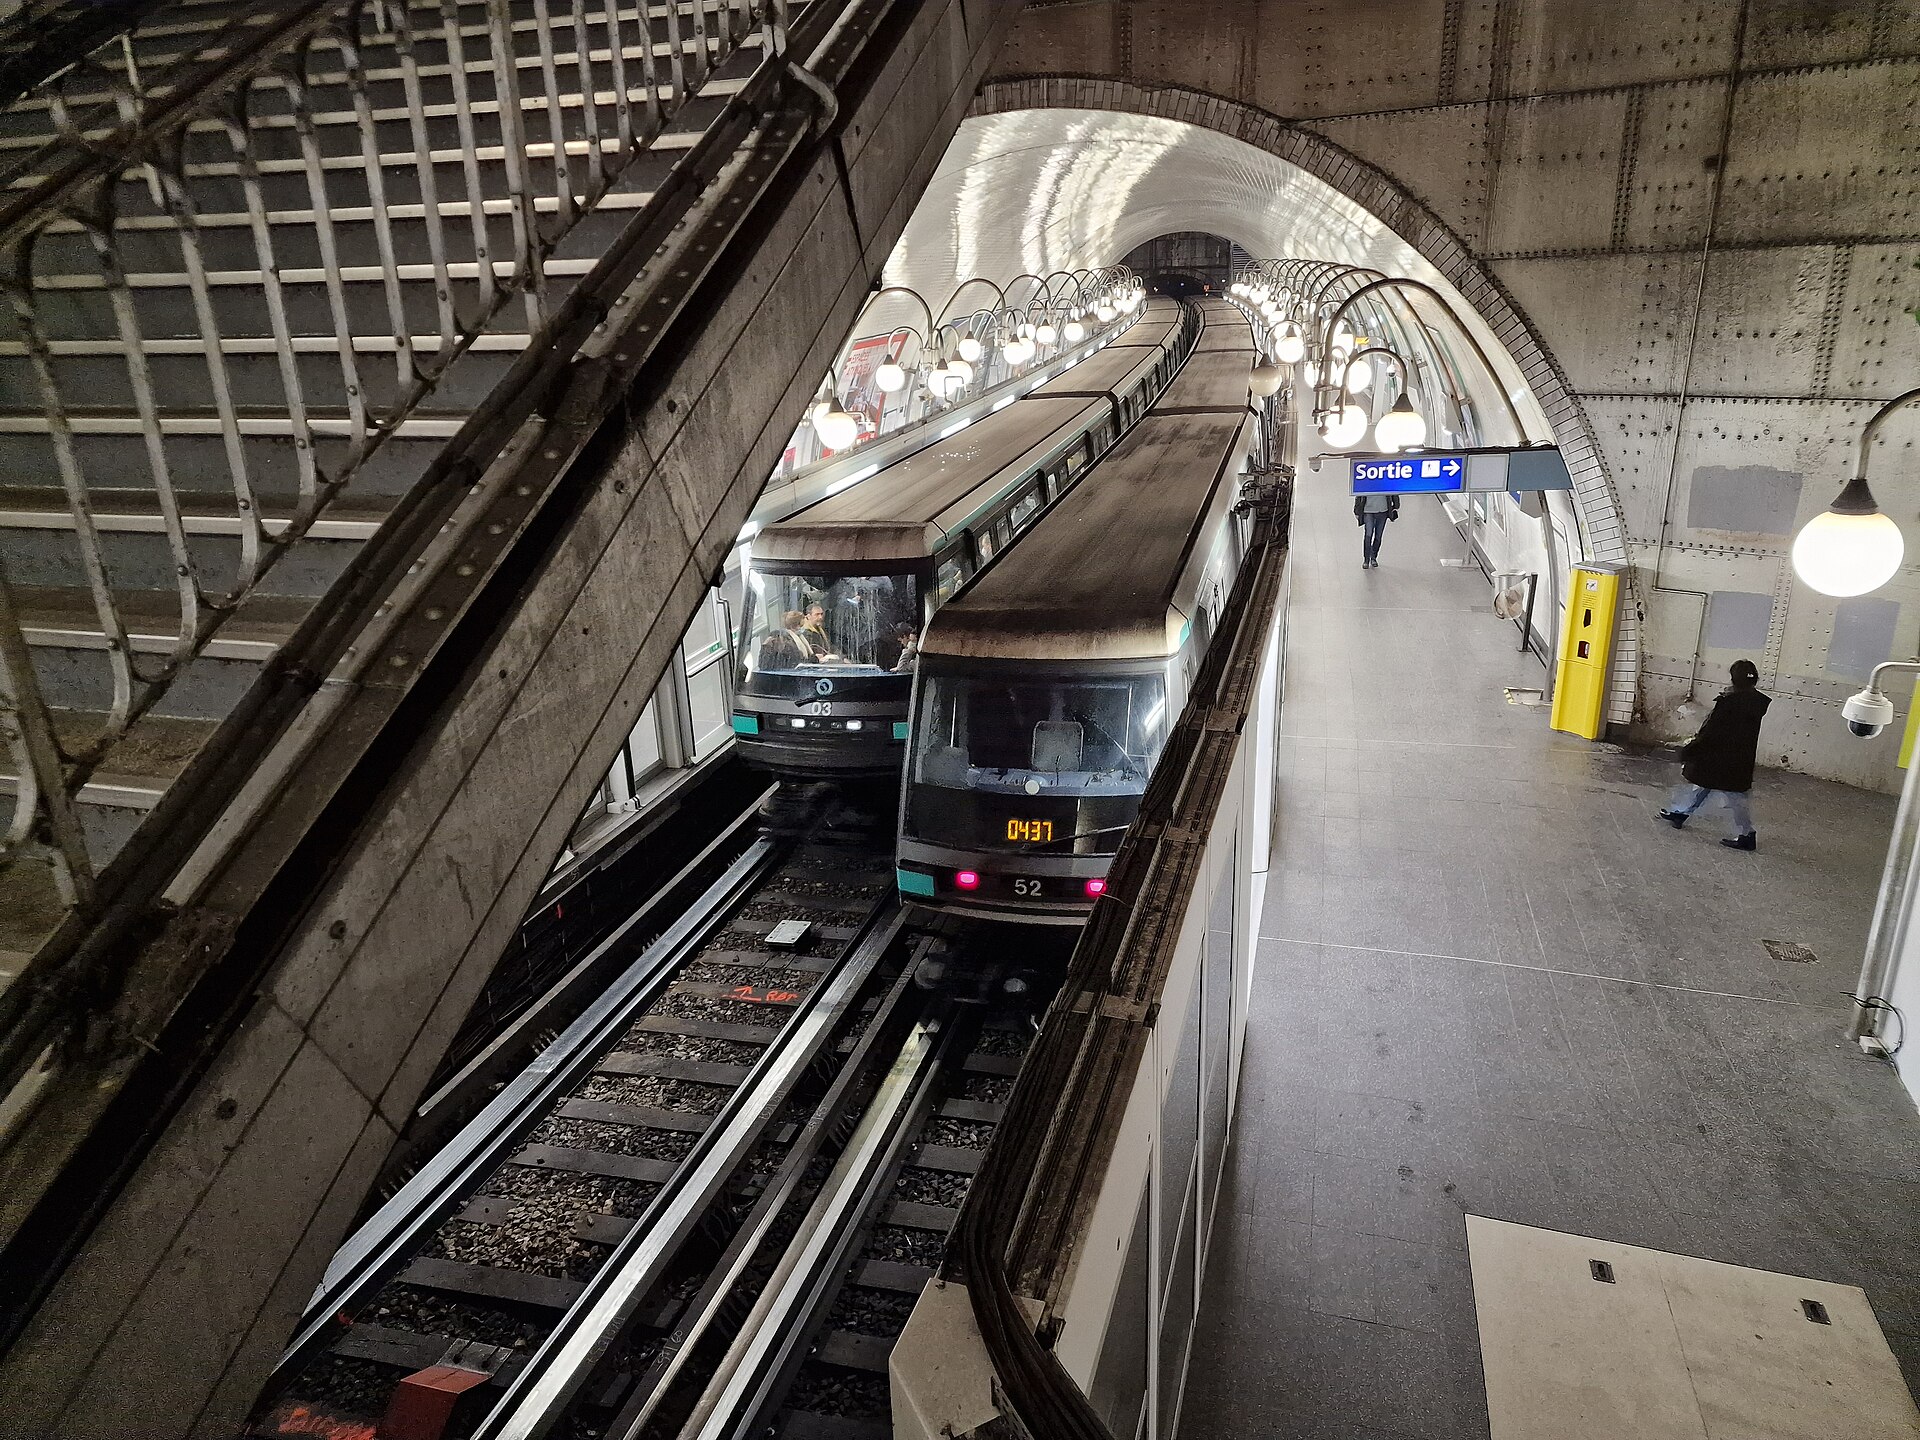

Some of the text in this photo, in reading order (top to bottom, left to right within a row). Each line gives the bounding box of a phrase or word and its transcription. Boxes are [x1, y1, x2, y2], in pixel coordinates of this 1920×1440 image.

[1355, 461, 1413, 480] Sortie
[811, 701, 832, 716] 03
[1007, 819, 1053, 842] 0437
[1014, 879, 1042, 897] 52
